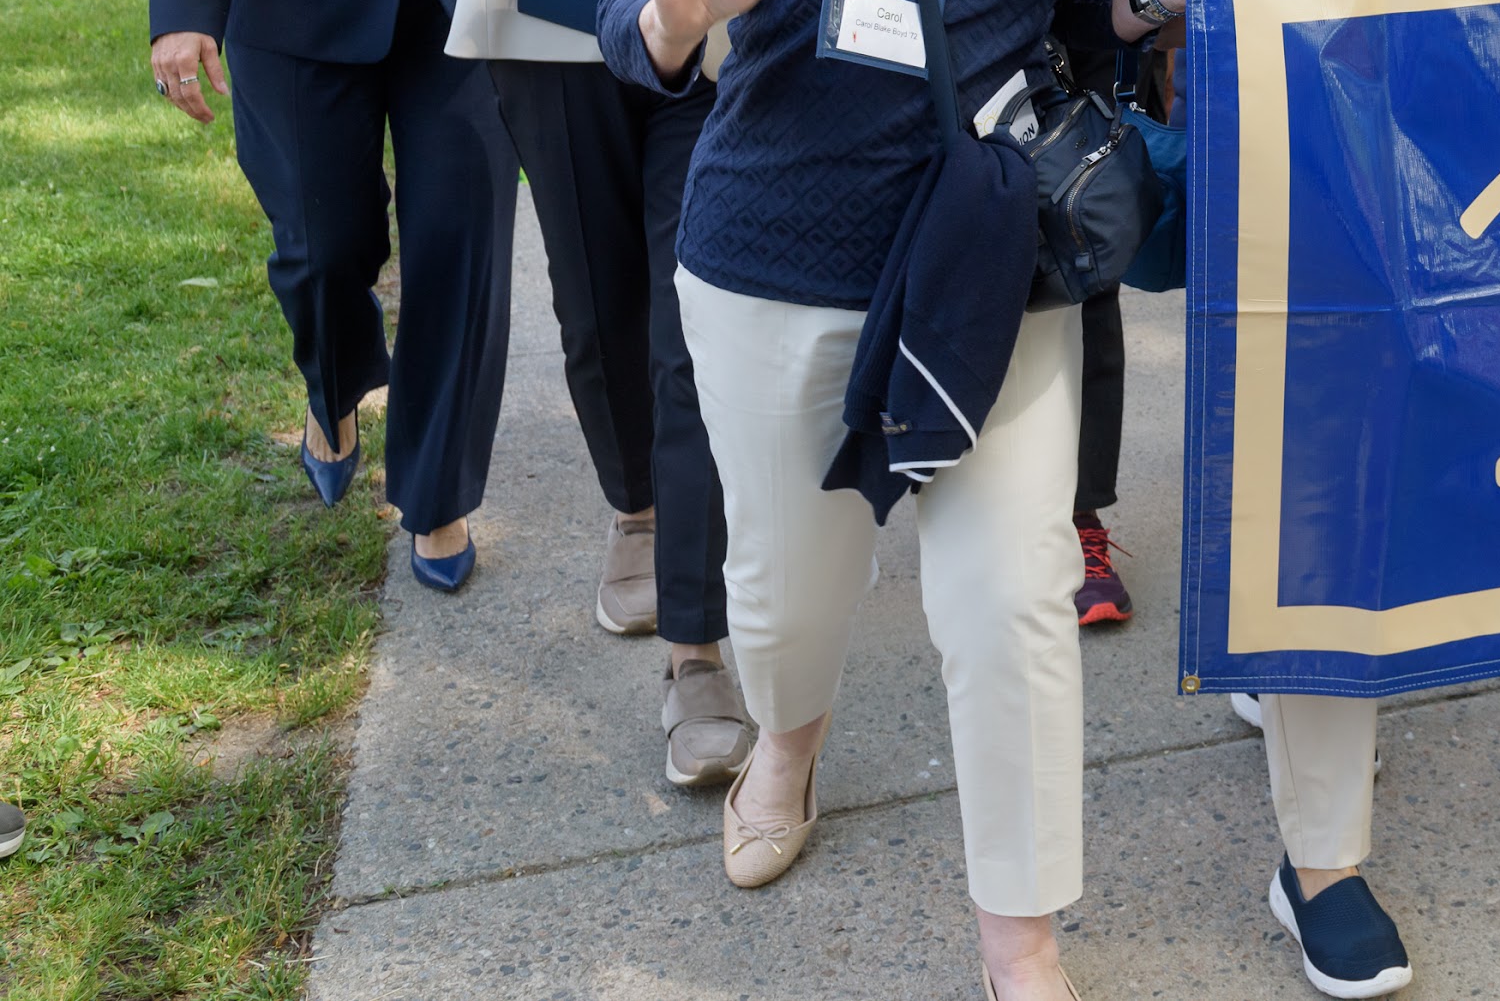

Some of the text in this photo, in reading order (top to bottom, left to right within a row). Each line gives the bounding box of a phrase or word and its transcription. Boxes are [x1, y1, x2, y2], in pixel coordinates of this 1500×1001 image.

[876, 7, 903, 23] Carol
[855, 18, 873, 29] Carol
[873, 22, 891, 33] Blake
[892, 27, 908, 38] Boyd
